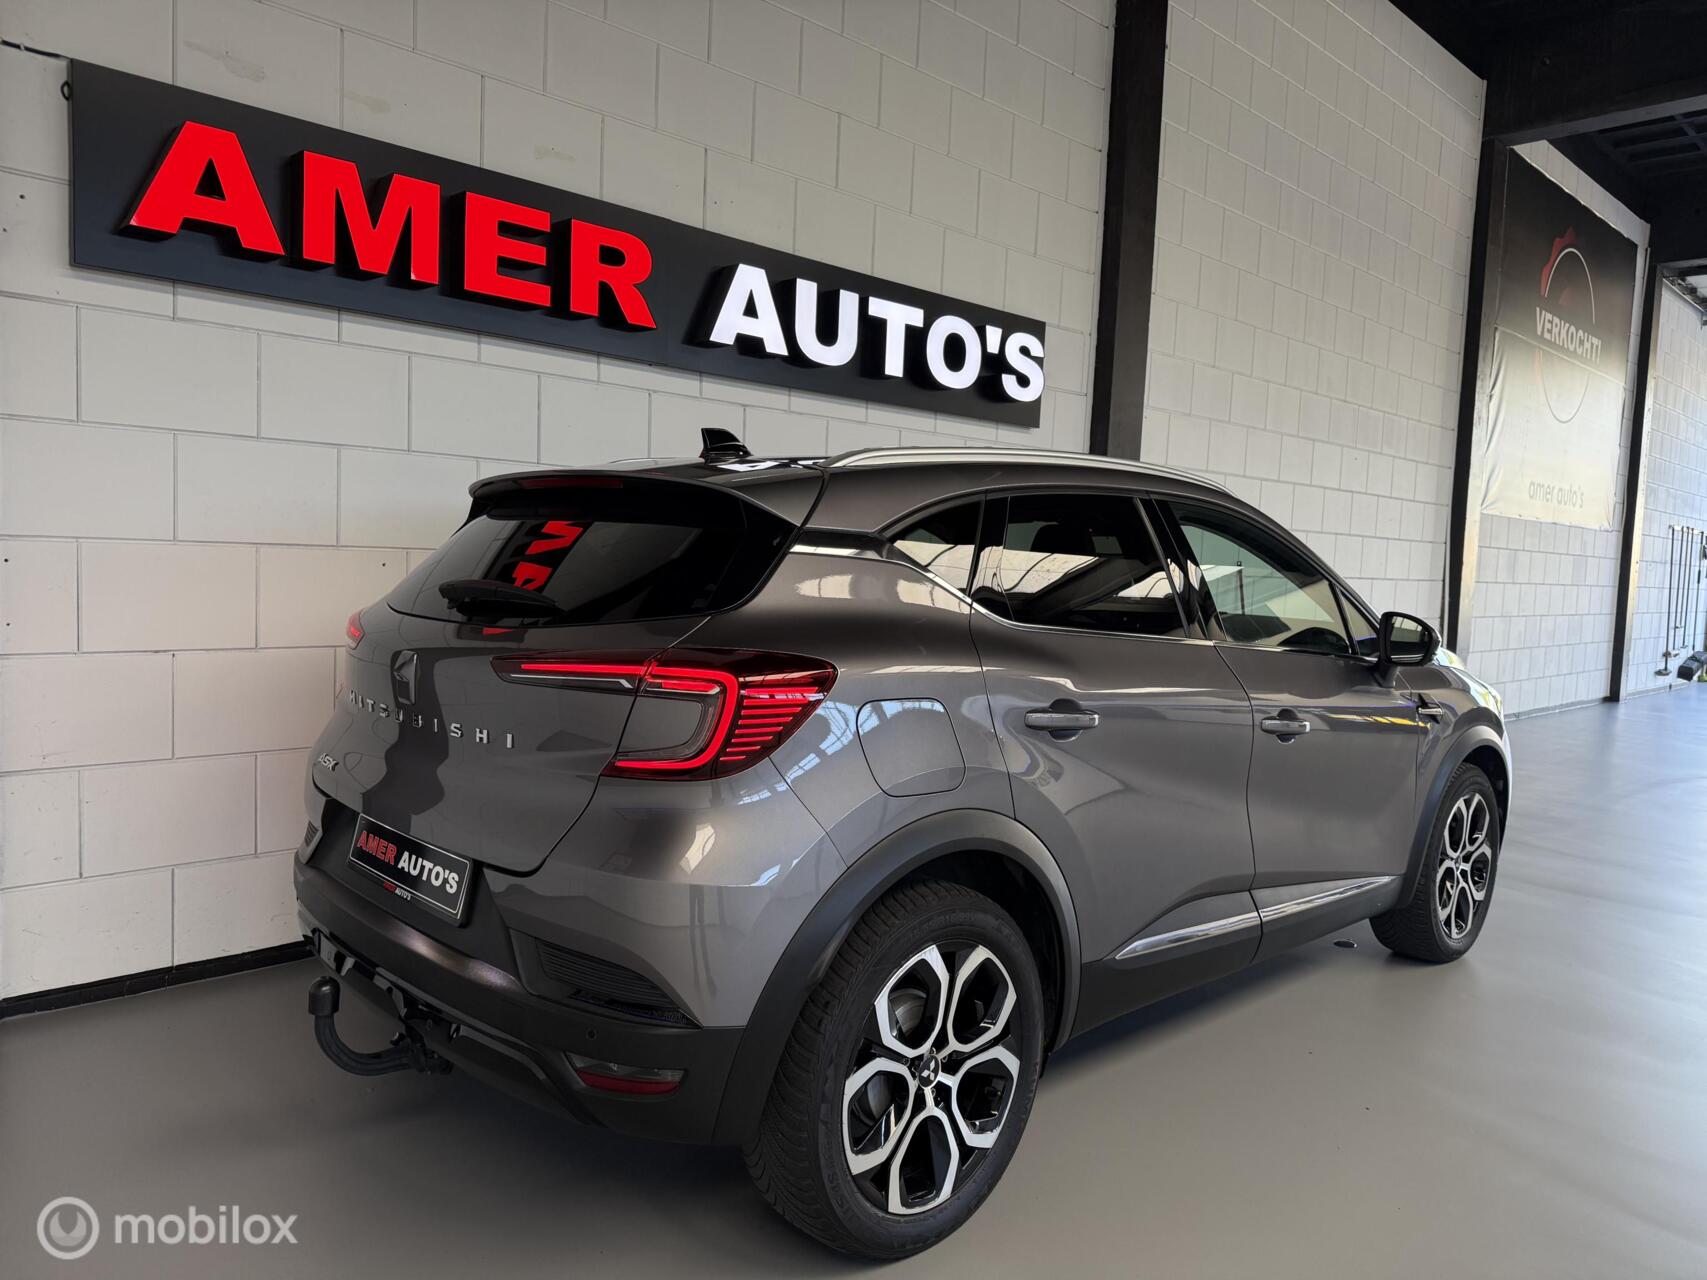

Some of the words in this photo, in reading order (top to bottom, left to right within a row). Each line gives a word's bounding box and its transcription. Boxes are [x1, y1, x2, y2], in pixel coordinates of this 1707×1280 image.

[129, 121, 656, 329] AMER
[709, 263, 1045, 402] AUTO'S
[1528, 481, 1555, 503] amer
[1557, 483, 1584, 509] auto's
[349, 689, 513, 749] MITSUBISHI
[357, 830, 398, 866] AMER
[397, 850, 460, 894] AUTO'S
